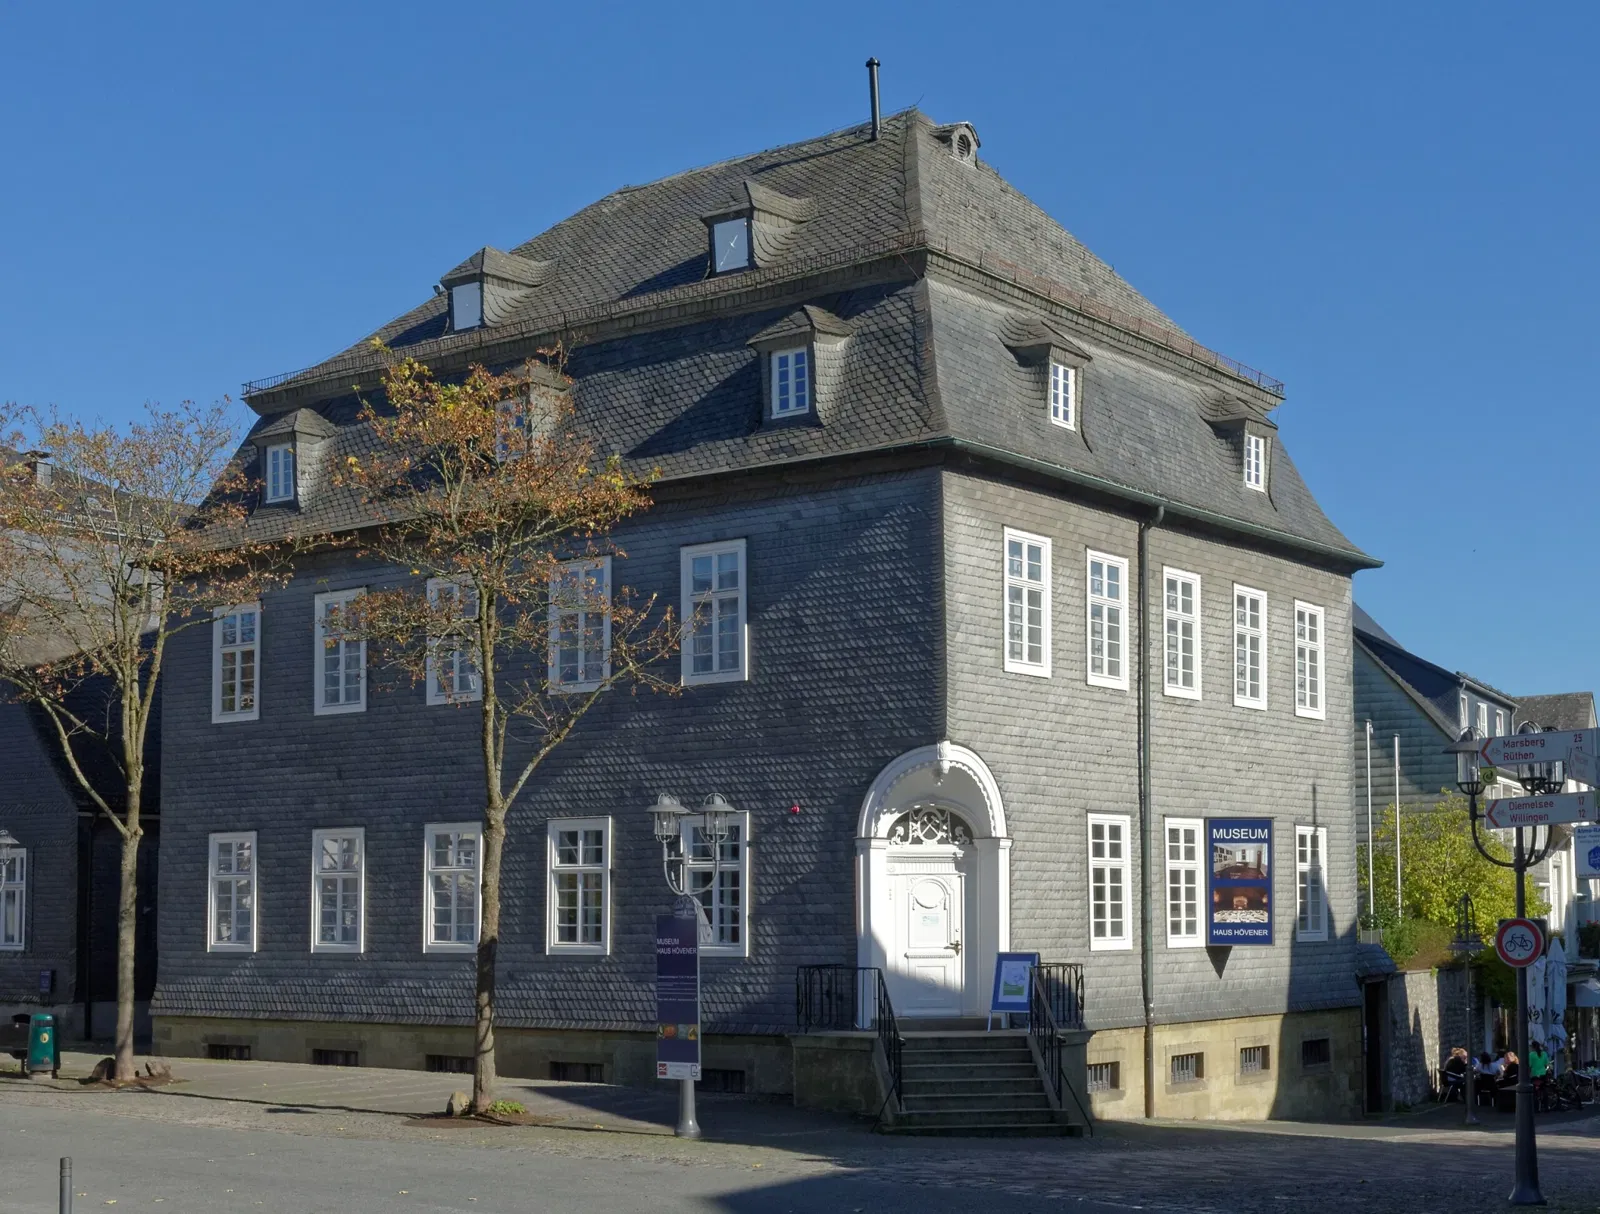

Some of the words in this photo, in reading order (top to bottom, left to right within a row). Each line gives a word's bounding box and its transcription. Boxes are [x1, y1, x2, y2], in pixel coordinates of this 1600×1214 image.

[1502, 737, 1546, 749] Marsberg
[1573, 733, 1583, 743] 25
[1503, 751, 1535, 761] Rüthen
[1508, 800, 1554, 811] Diemelsee
[1577, 796, 1585, 806] 17
[1509, 813, 1549, 823] Willingen
[1577, 809, 1586, 818] 12
[1212, 828, 1268, 839] MUSEUM
[1233, 928, 1268, 936] HÖVENER
[657, 947, 671, 955] HAUS
[672, 946, 697, 955] HÖVENER
